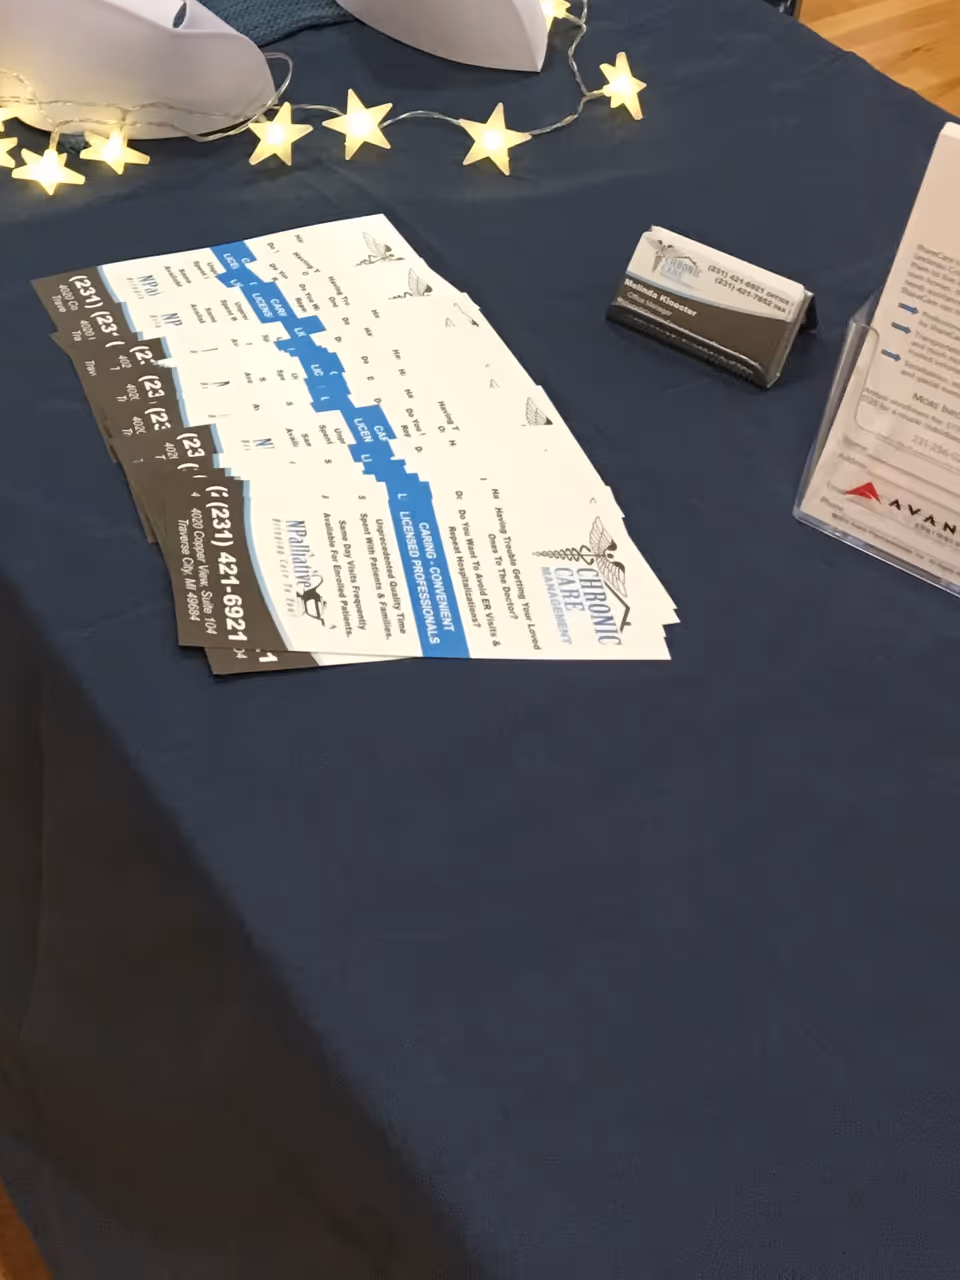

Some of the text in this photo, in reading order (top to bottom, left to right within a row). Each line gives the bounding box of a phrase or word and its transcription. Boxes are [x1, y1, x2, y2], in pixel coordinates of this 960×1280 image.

[69, 275, 103, 308] (231)
[624, 277, 658, 299] Melinda
[659, 293, 697, 318] Klooster
[191, 508, 203, 530] 4020
[359, 513, 371, 535] Spent
[458, 509, 467, 520] Do
[461, 522, 472, 537] You
[177, 519, 193, 555] Traverse
[192, 531, 208, 562] Copper
[366, 537, 376, 555] With
[466, 538, 477, 558] Want
[285, 520, 315, 588] NPalliative
[471, 561, 481, 571] To
[184, 578, 196, 590] MI
[206, 502, 247, 641] (231) 421-6921
[323, 513, 353, 638] Available For Enrolled Patients.
[338, 520, 367, 630] Same Day Visits Frequently
[369, 557, 384, 590] Patients
[375, 519, 407, 634] Unprecedented Quality Time
[399, 511, 440, 644] LICENSED PROFESSIONALS
[418, 522, 436, 559] CARING
[429, 567, 455, 632] CONVENIENT
[448, 526, 481, 627] Repeat Hospitalizations?
[474, 573, 487, 596] Avoid
[488, 533, 518, 620] Ones To The Doctor?
[494, 507, 540, 650] Having Trouble Getting Your Loved
[201, 591, 214, 614] Suite
[481, 599, 491, 610] ER
[541, 566, 572, 645] MANAGEMENT
[553, 567, 585, 612] CARE
[187, 592, 200, 621] 49684
[378, 602, 393, 640] Families.
[576, 567, 622, 646] CHRONIC
[205, 617, 217, 635] 104
[485, 613, 497, 637] Visits
